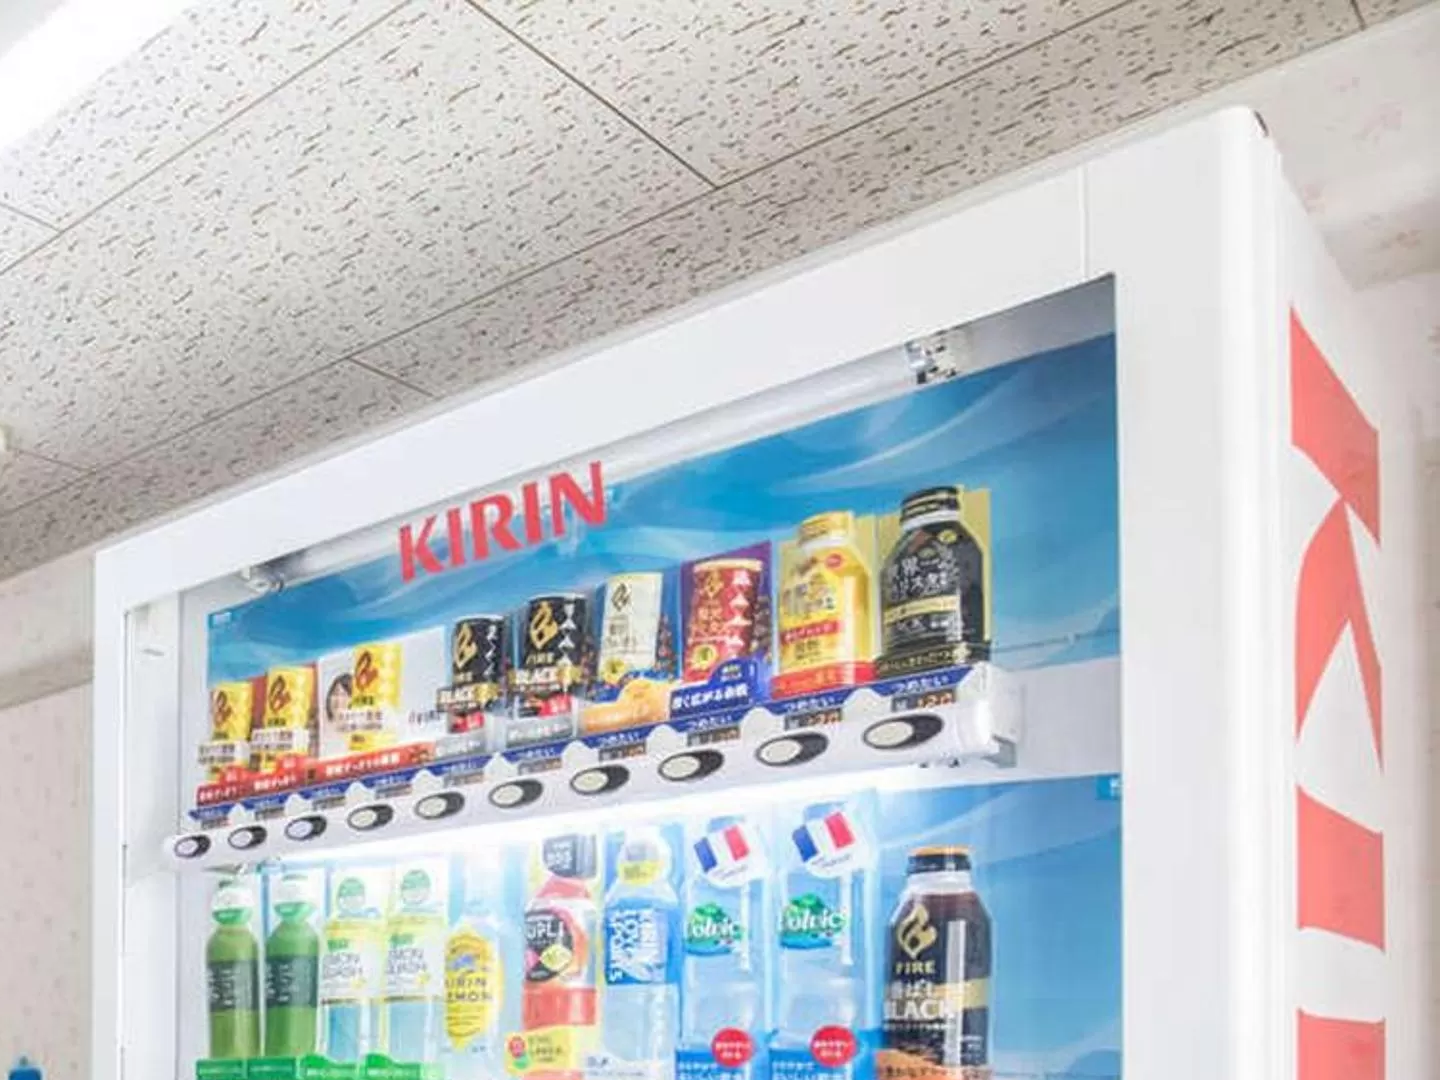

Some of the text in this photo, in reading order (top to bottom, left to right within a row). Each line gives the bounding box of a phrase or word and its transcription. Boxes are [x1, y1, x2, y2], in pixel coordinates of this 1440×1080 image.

[398, 460, 607, 584] KIRIN
[896, 675, 949, 695] つめたい
[785, 696, 838, 713] つめたい
[895, 961, 936, 975] FIRE
